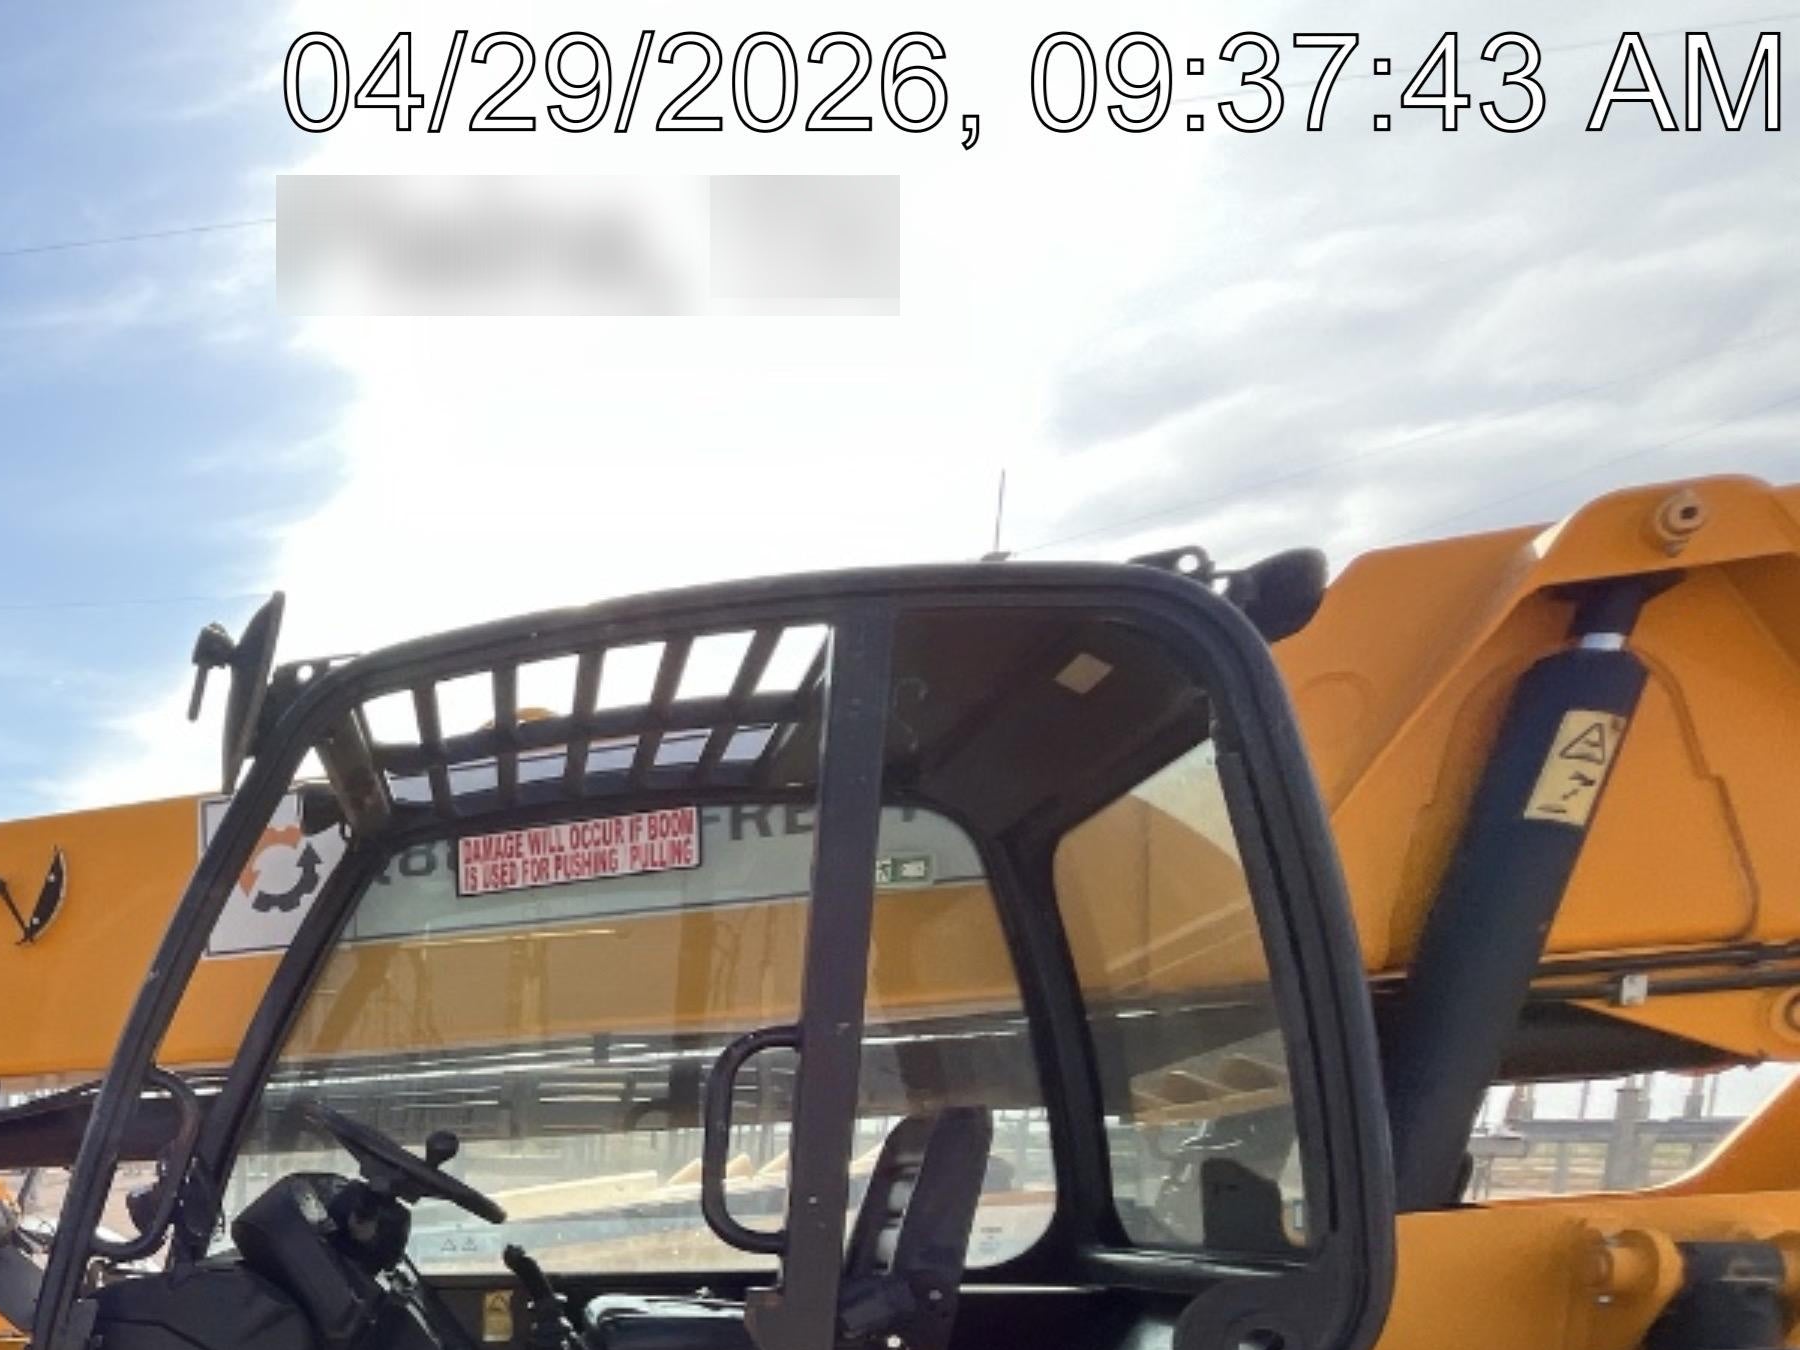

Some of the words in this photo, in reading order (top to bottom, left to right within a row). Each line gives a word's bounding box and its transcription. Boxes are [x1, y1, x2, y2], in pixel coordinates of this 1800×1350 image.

[463, 833, 523, 864] DAMAGE
[527, 828, 565, 855] WILL
[569, 818, 624, 851] OCCUR
[630, 815, 643, 843] IF
[647, 808, 694, 841] BOOM
[464, 865, 478, 892] IS
[482, 860, 518, 889] USED
[522, 856, 550, 883] FOR
[554, 847, 618, 880] PUSHING
[630, 837, 692, 872] PULLING
